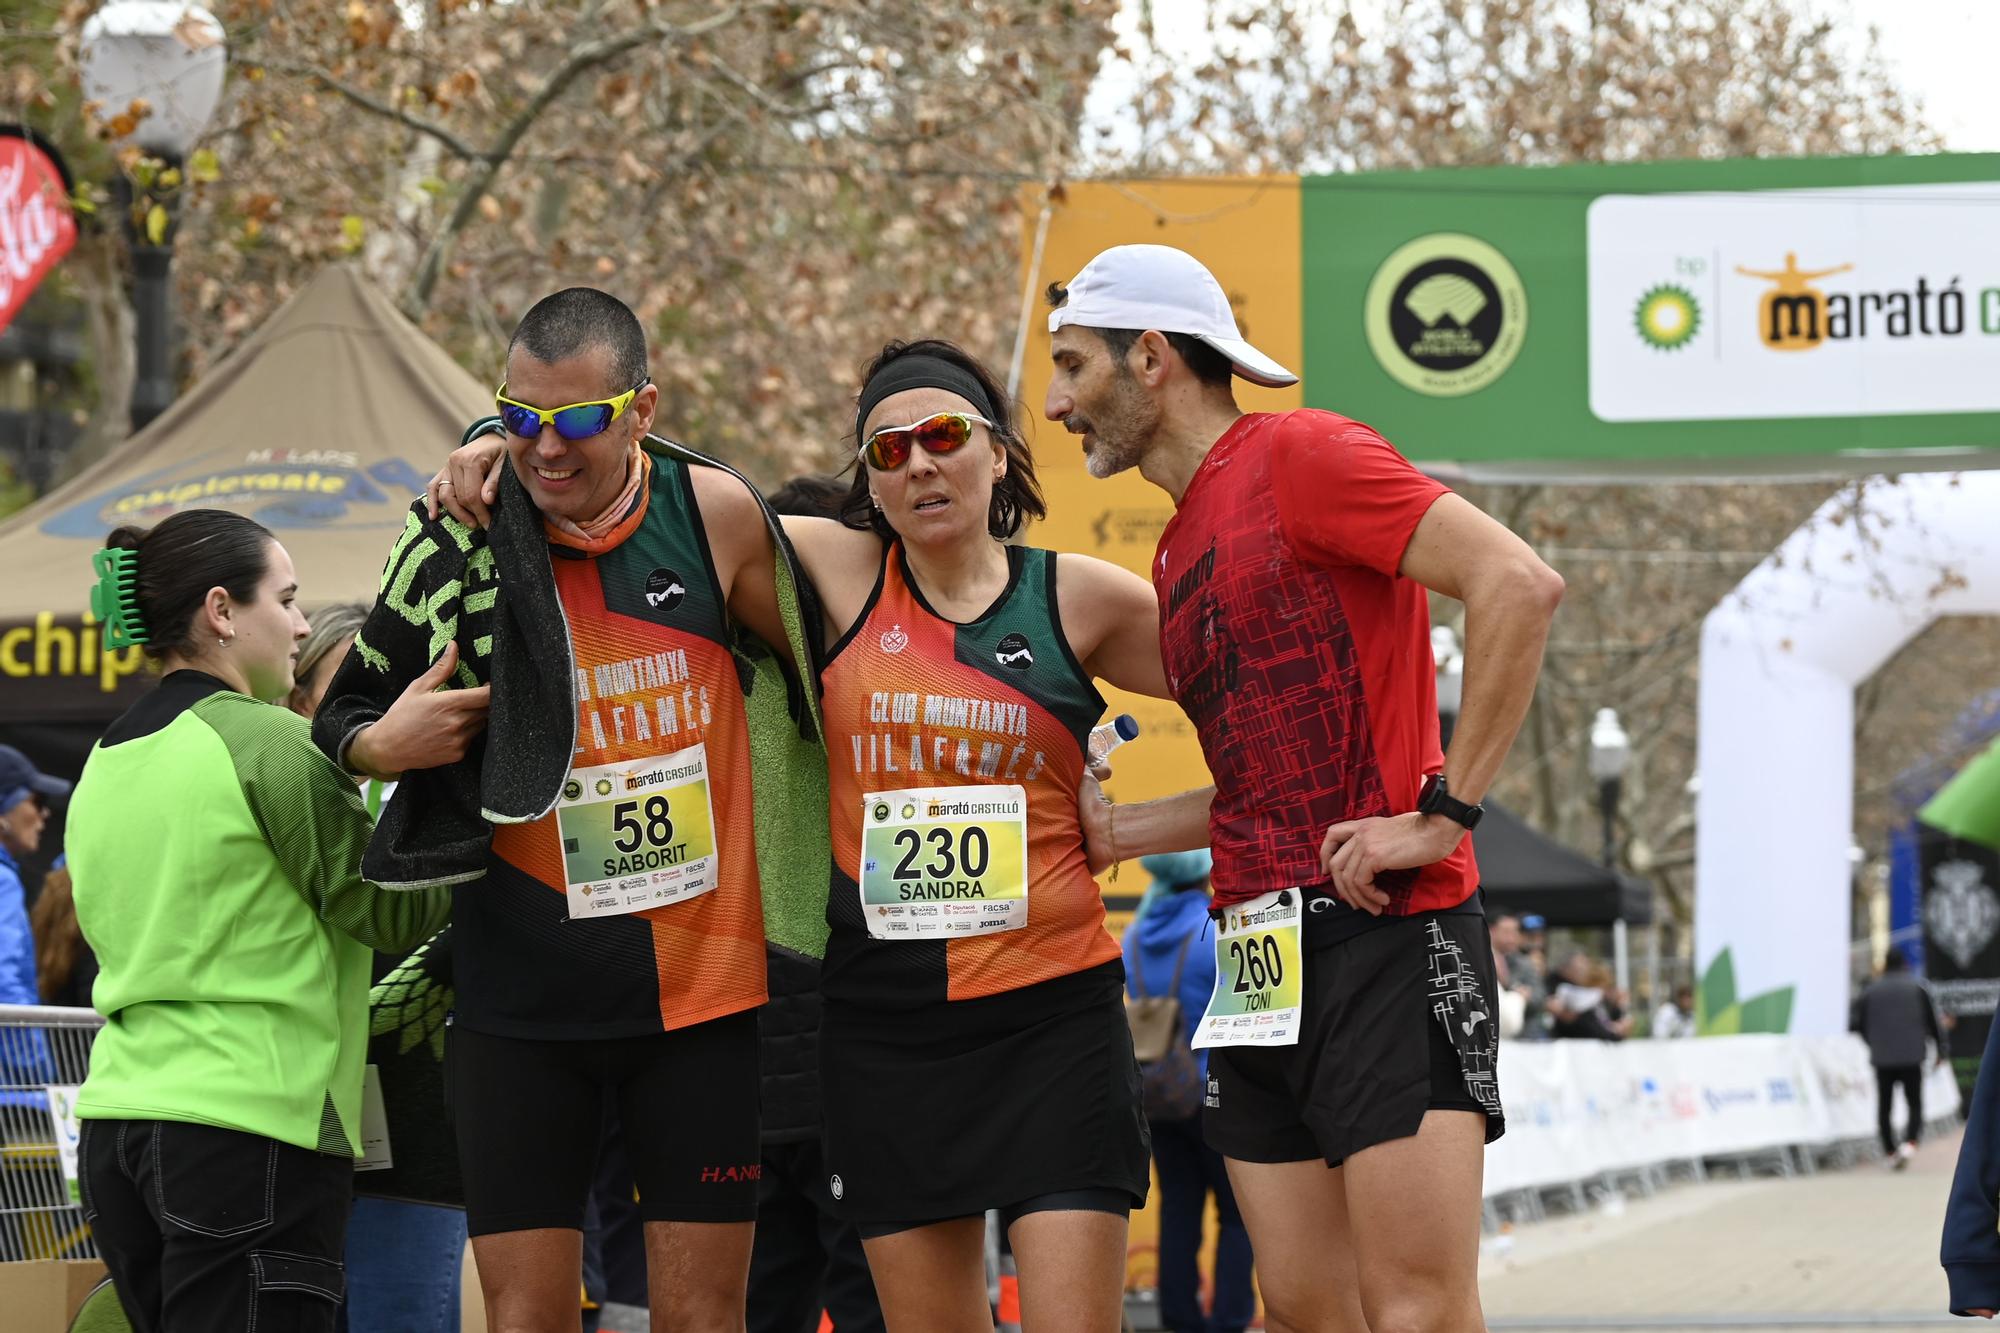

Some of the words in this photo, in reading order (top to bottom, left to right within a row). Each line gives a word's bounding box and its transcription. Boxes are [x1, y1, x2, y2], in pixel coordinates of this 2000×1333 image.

[1769, 276, 1965, 342] marató
[870, 692, 918, 724] CLUB
[851, 734, 1046, 781] VILAFAMÉS
[626, 770, 664, 790] marató
[665, 760, 703, 781] CASTELLÓ
[612, 795, 674, 853] 58
[927, 801, 969, 817] marató
[971, 801, 1019, 814] CASTELLÓ
[603, 843, 687, 877] SABORIT
[892, 826, 989, 881] 230
[899, 881, 985, 900] SANDRA
[1230, 934, 1283, 994] 260
[1244, 991, 1272, 1011] TONI
